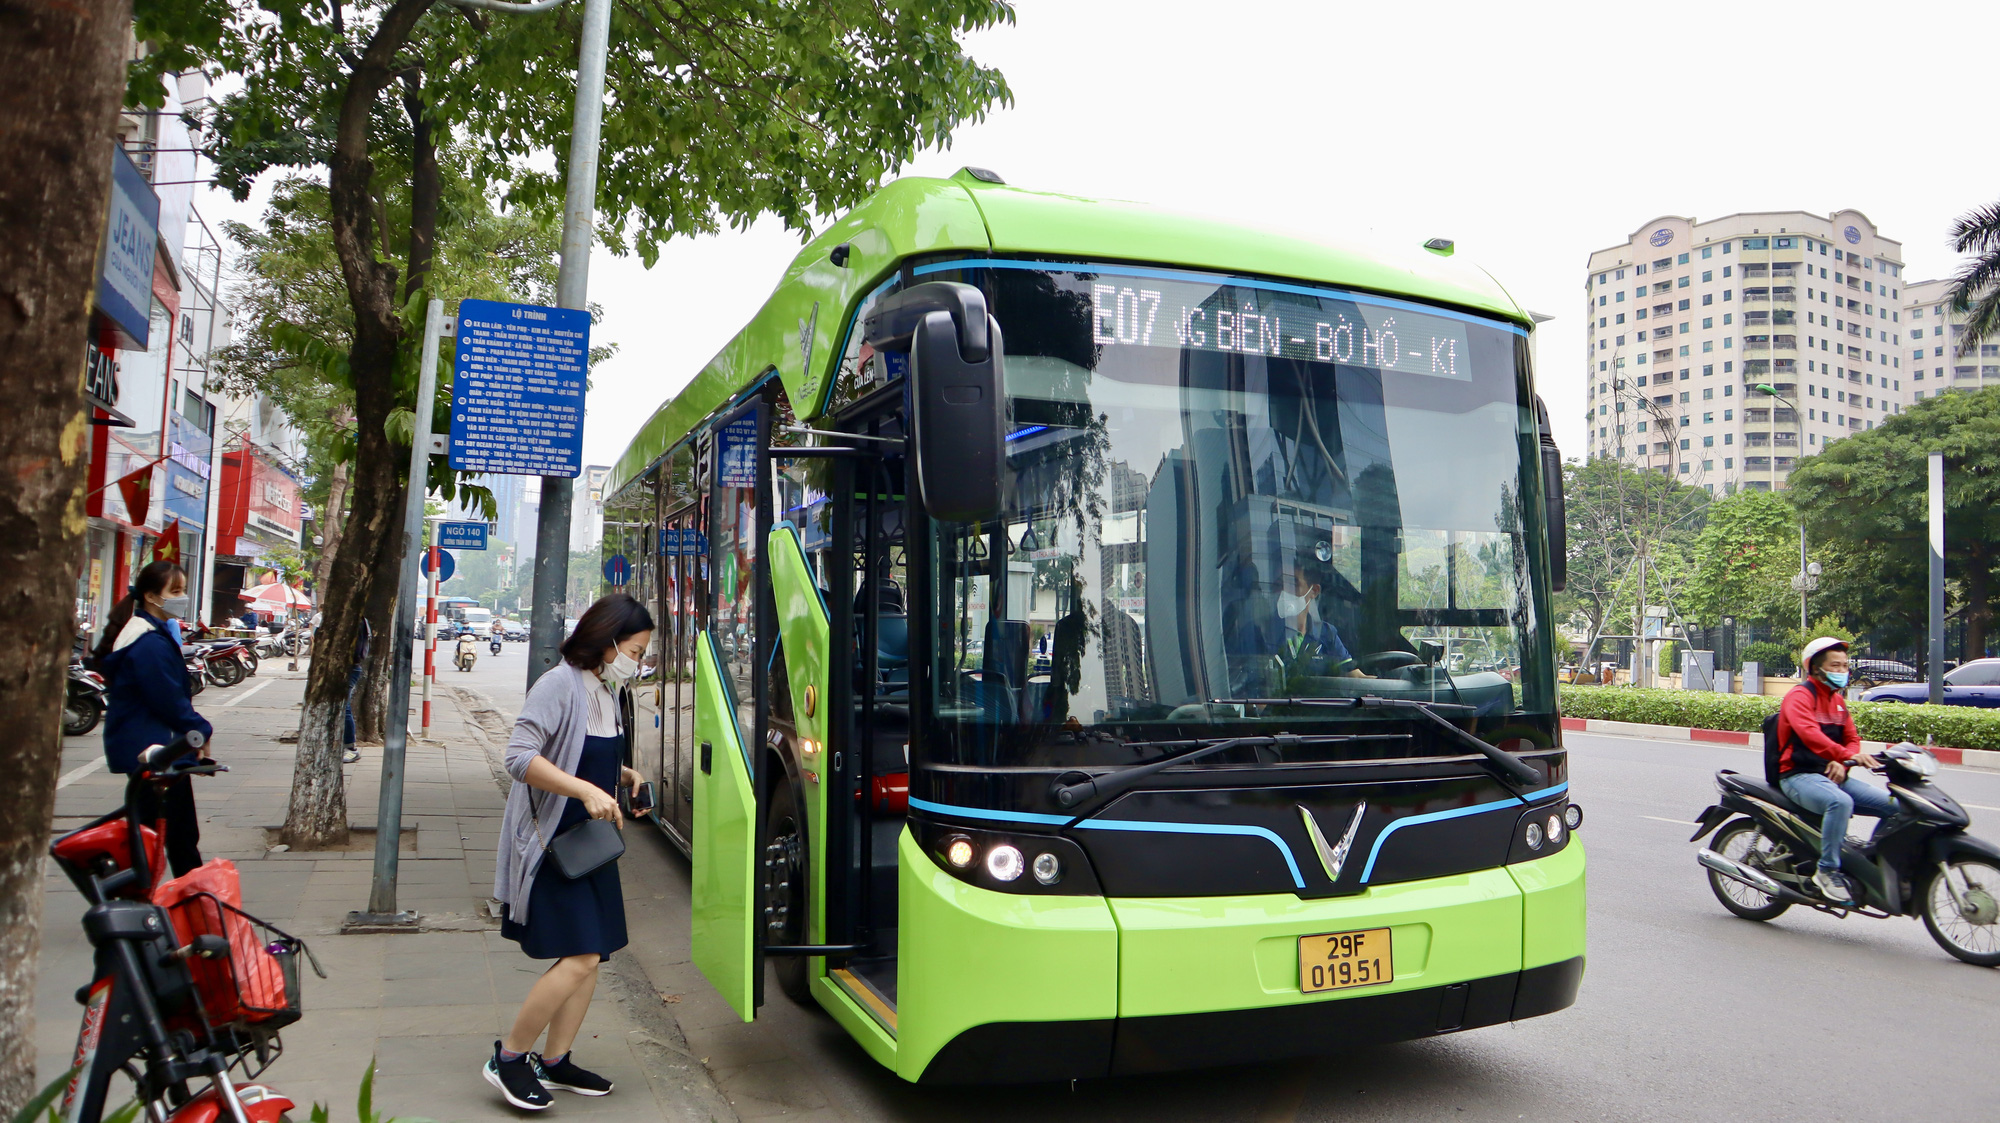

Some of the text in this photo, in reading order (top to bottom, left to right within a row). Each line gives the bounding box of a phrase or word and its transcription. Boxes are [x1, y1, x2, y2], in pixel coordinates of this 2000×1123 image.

[113, 208, 151, 278] JEANS
[512, 308, 547, 320] LỘ TRÌNH
[1094, 283, 1161, 346] E07
[1217, 301, 1280, 355] BIÊN
[86, 340, 121, 408] EANS
[467, 528, 480, 536] 140
[1326, 933, 1365, 960] 29F
[1312, 958, 1381, 988] 019.51
